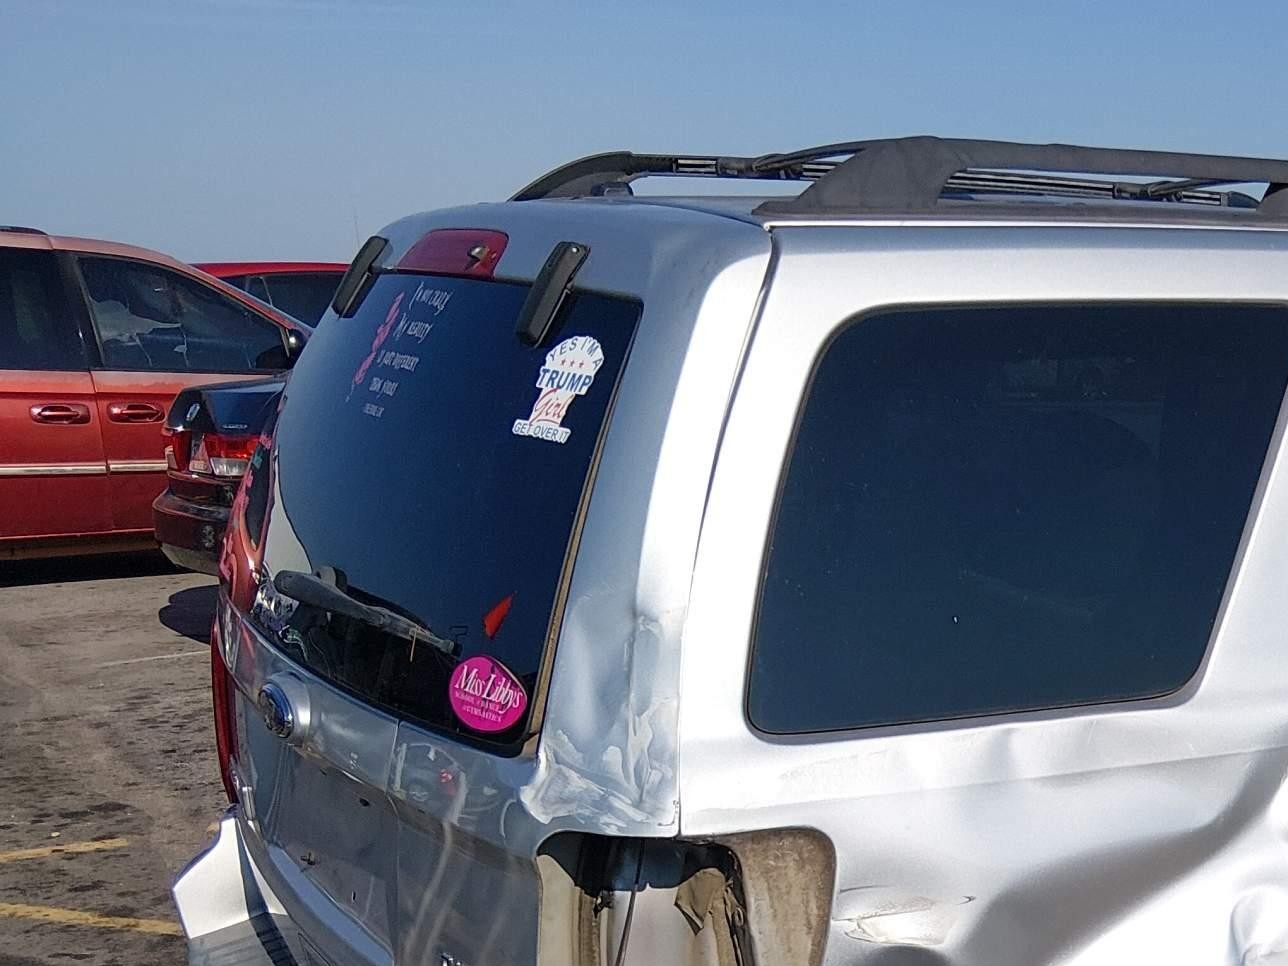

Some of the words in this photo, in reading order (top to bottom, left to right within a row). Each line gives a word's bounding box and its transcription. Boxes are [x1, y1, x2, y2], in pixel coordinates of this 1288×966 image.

[549, 338, 579, 361] YES
[580, 338, 600, 358] I'M
[592, 357, 603, 370] A
[538, 367, 593, 393] TRUMP
[528, 388, 576, 426] Girl
[513, 421, 532, 435] GET
[533, 425, 558, 440] OVER
[558, 431, 571, 443] IT
[454, 665, 486, 696] Miss
